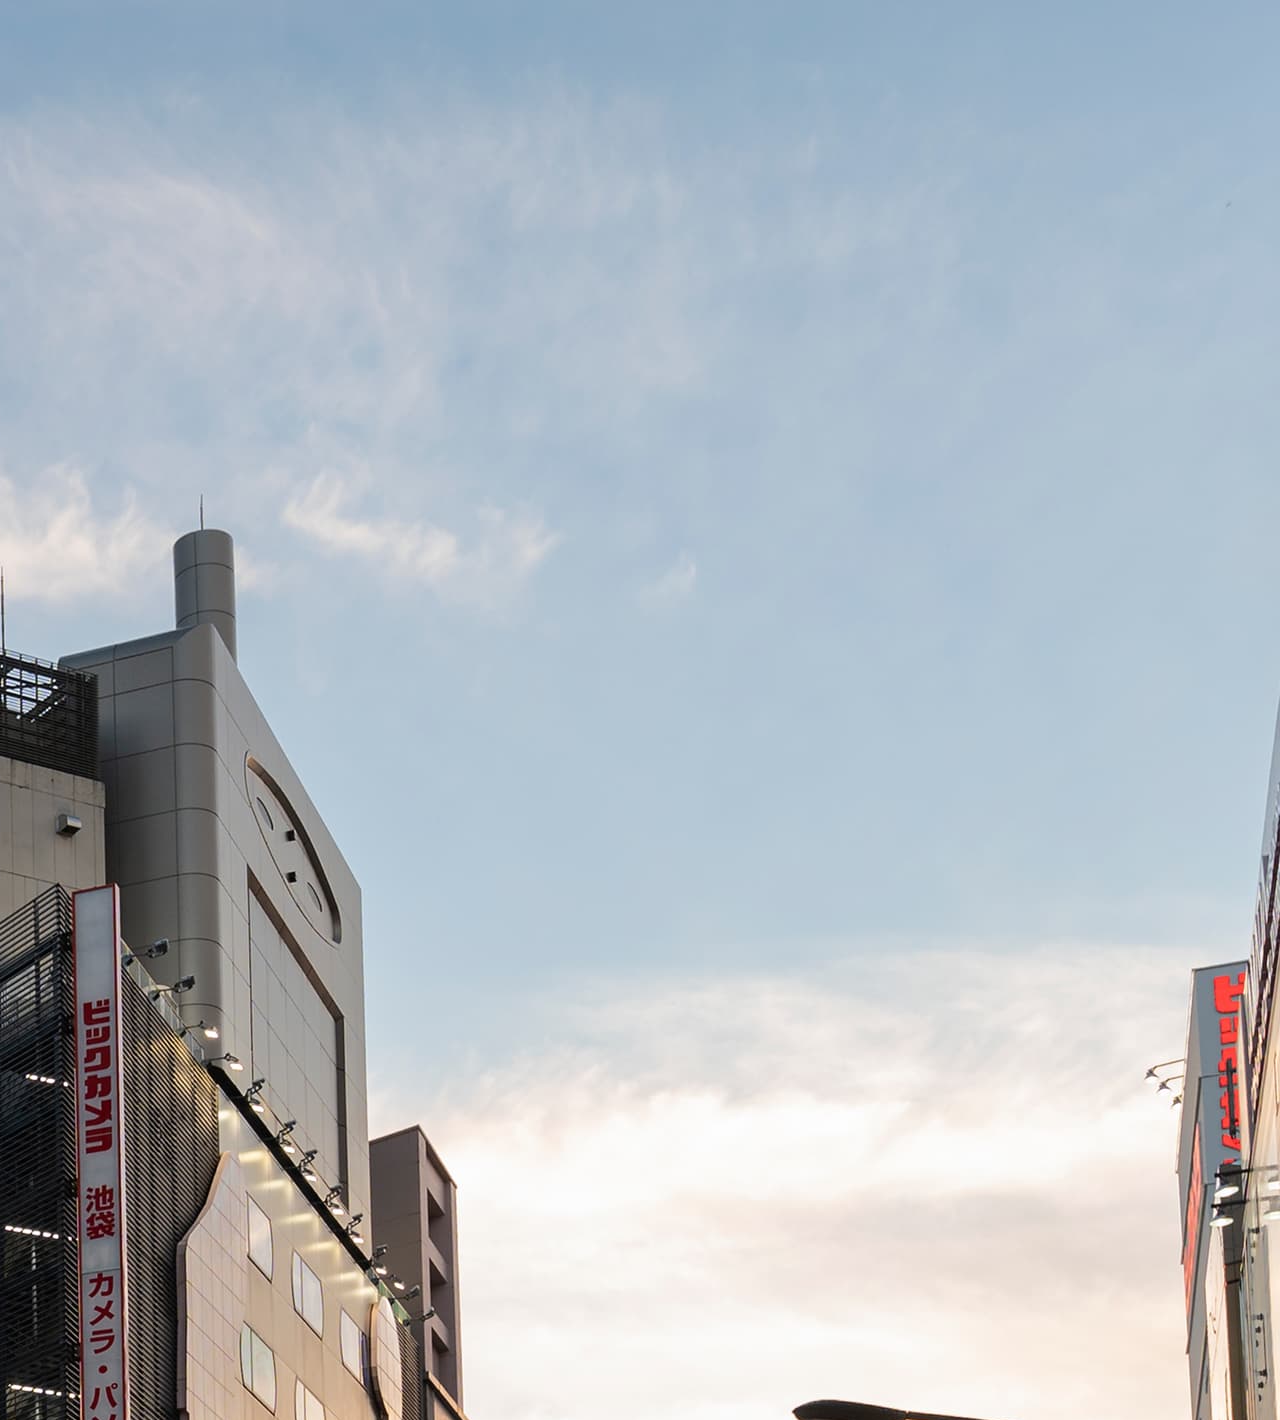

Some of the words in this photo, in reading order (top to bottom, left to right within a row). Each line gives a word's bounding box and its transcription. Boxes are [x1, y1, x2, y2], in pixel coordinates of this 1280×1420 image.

[83, 999, 113, 1155] ビックカメラ
[85, 1184, 116, 1241] 池袋
